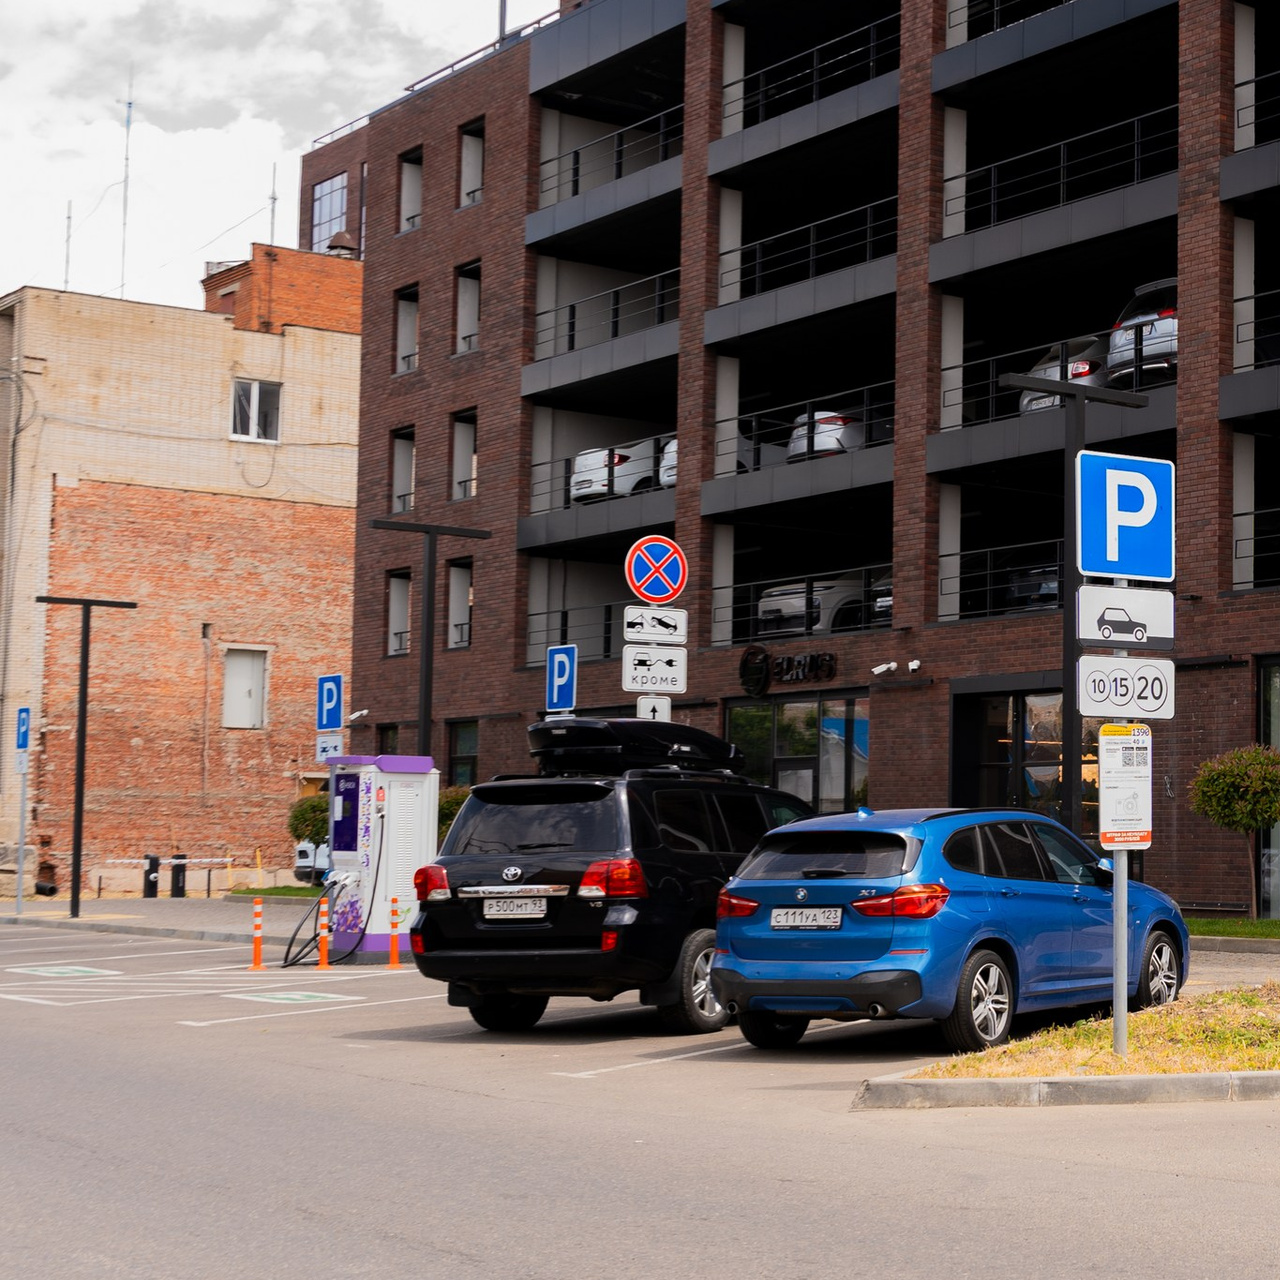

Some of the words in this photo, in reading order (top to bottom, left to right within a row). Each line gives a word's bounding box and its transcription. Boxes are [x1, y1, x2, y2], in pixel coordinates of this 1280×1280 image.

[1106, 468, 1158, 562] P
[553, 653, 571, 703] P
[631, 674, 678, 688] кроме
[1091, 678, 1106, 694] 10
[1112, 676, 1129, 697] 15
[1137, 676, 1163, 701] 20
[322, 682, 338, 725] P
